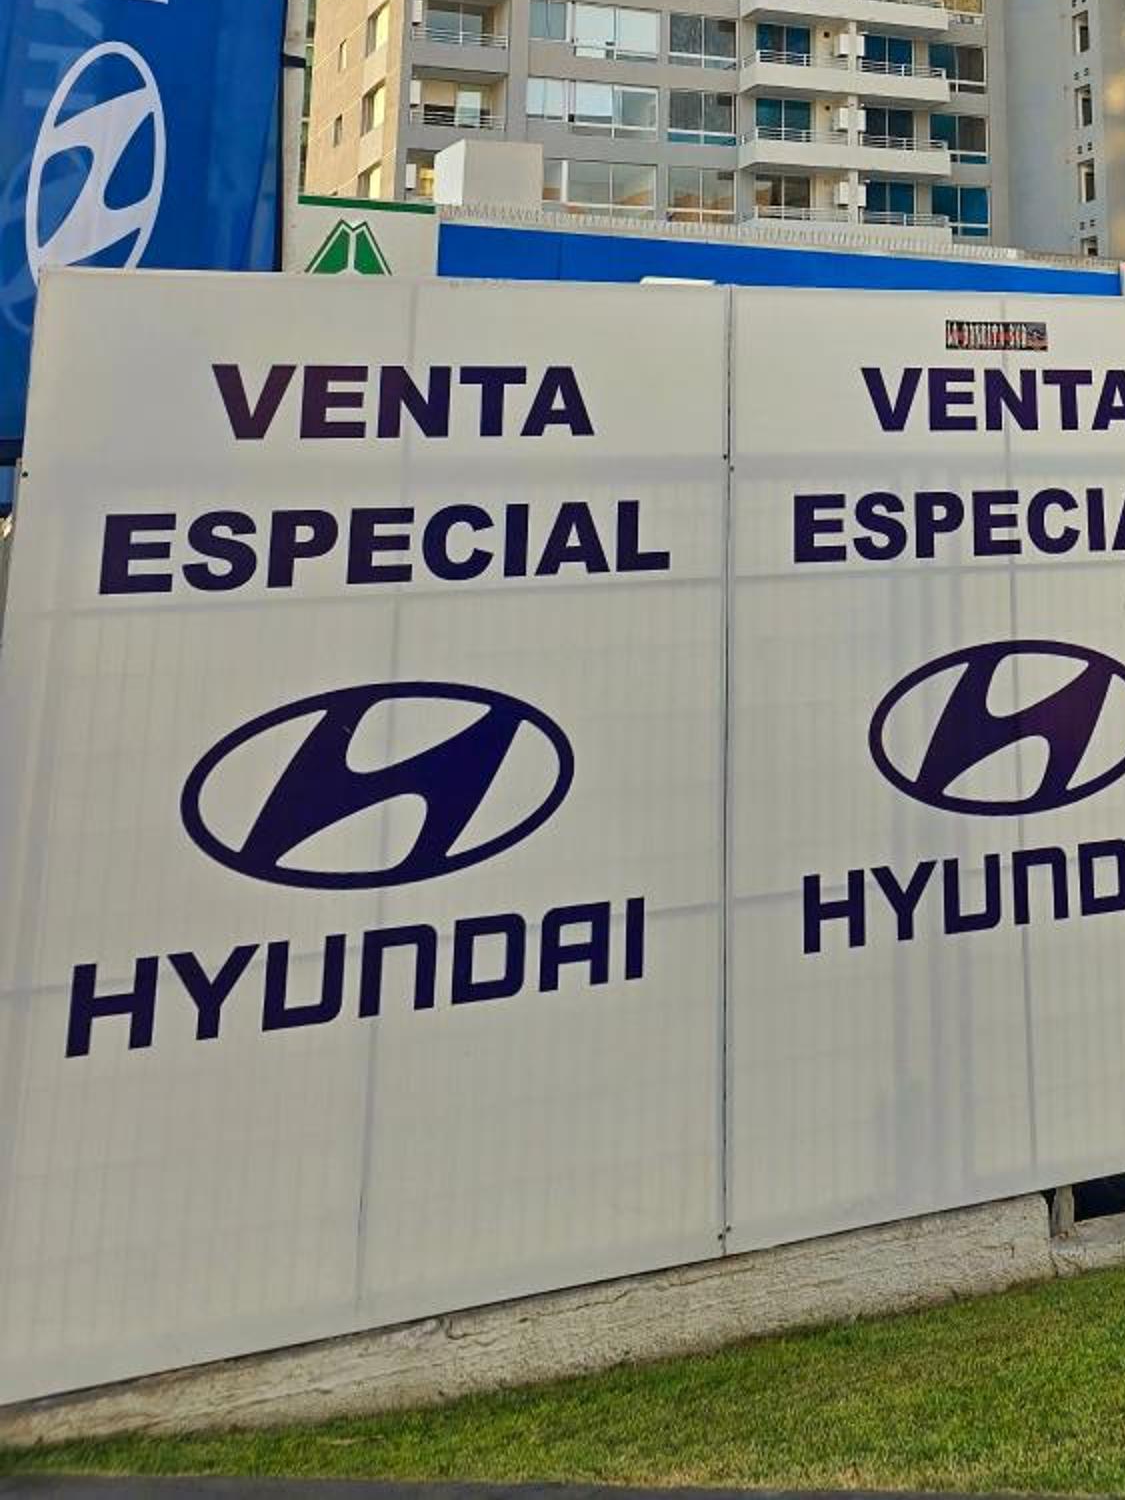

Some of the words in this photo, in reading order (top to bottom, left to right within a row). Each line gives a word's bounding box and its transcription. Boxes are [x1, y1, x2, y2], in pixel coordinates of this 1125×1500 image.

[211, 362, 595, 442] VENTA
[98, 500, 671, 596] ESPECIAL
[65, 896, 645, 1059] HYUNDAI
